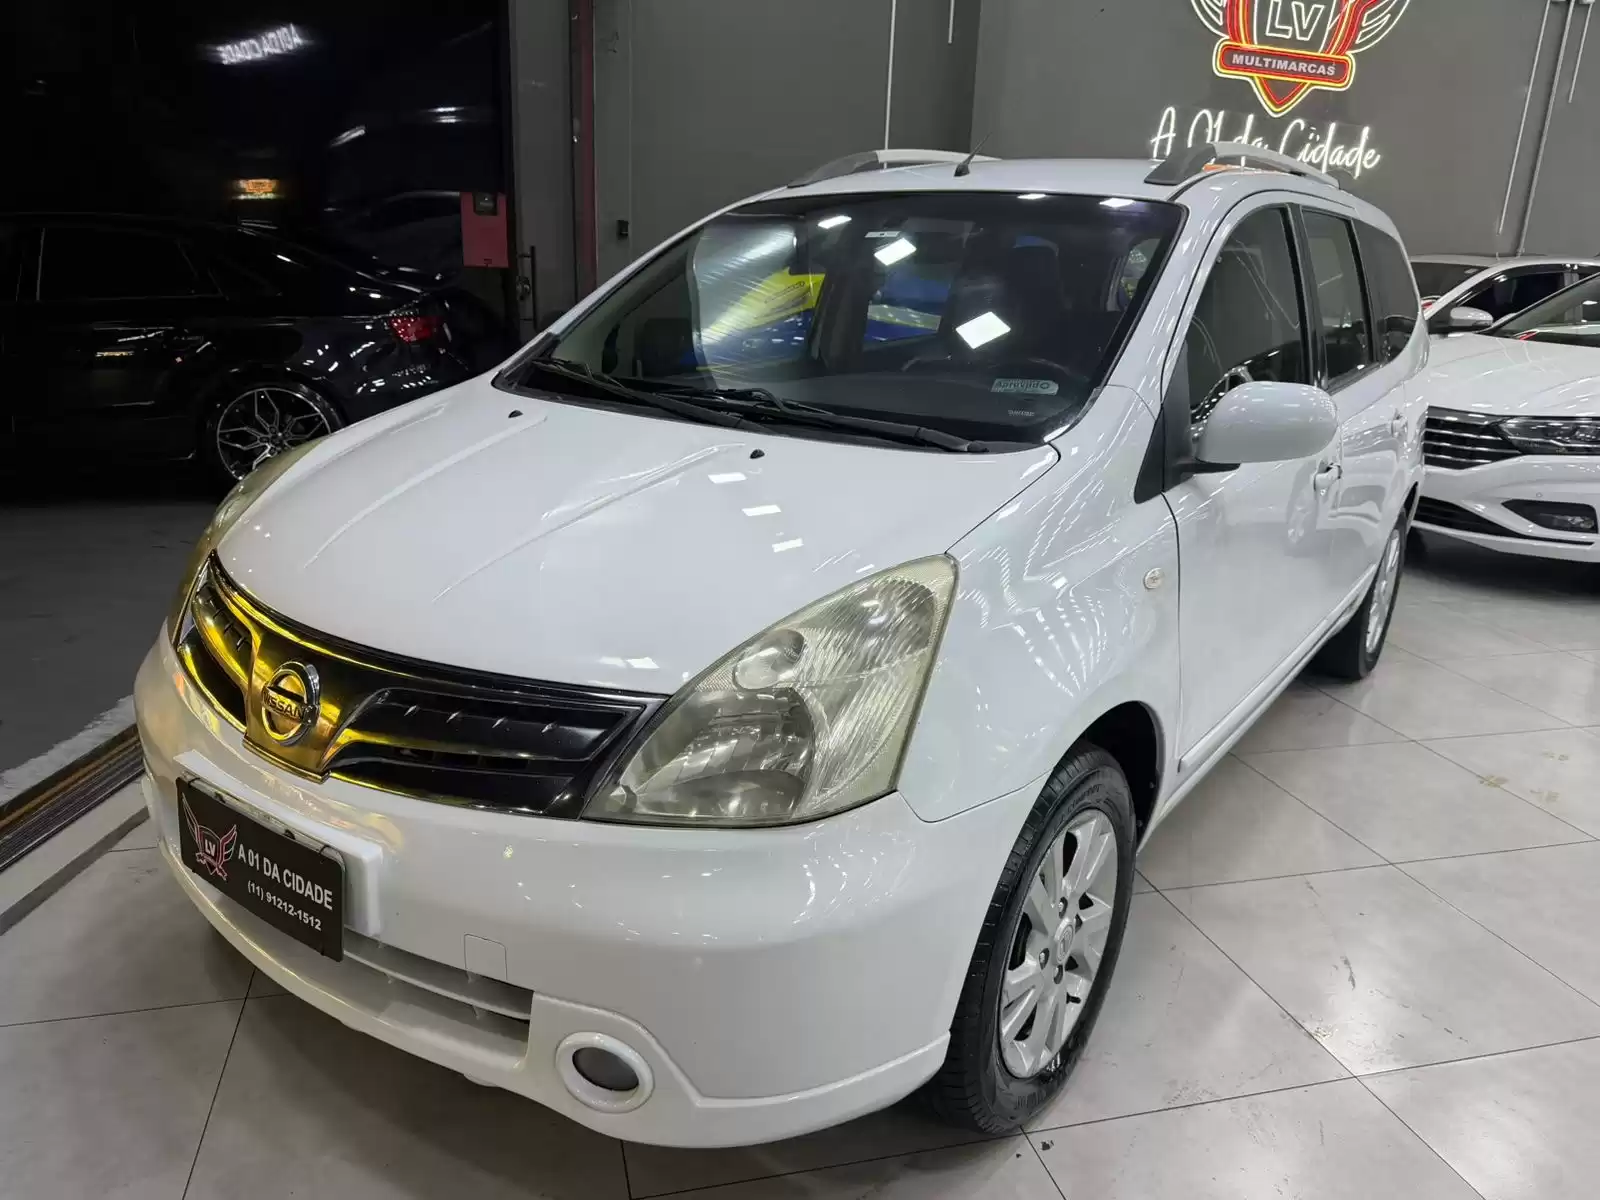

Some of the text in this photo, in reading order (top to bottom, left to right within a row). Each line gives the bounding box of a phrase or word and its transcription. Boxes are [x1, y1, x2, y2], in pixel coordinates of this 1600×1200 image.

[1266, 0, 1325, 41] LV
[1232, 53, 1336, 76] MULTIMARCAS
[1150, 106, 1176, 158] A
[1279, 118, 1381, 180] Cidade
[263, 690, 304, 720] NISSAN
[204, 838, 216, 857] LV
[238, 843, 333, 911] A 01 DA CIDADE
[247, 880, 322, 931] (11) 91212-1512
